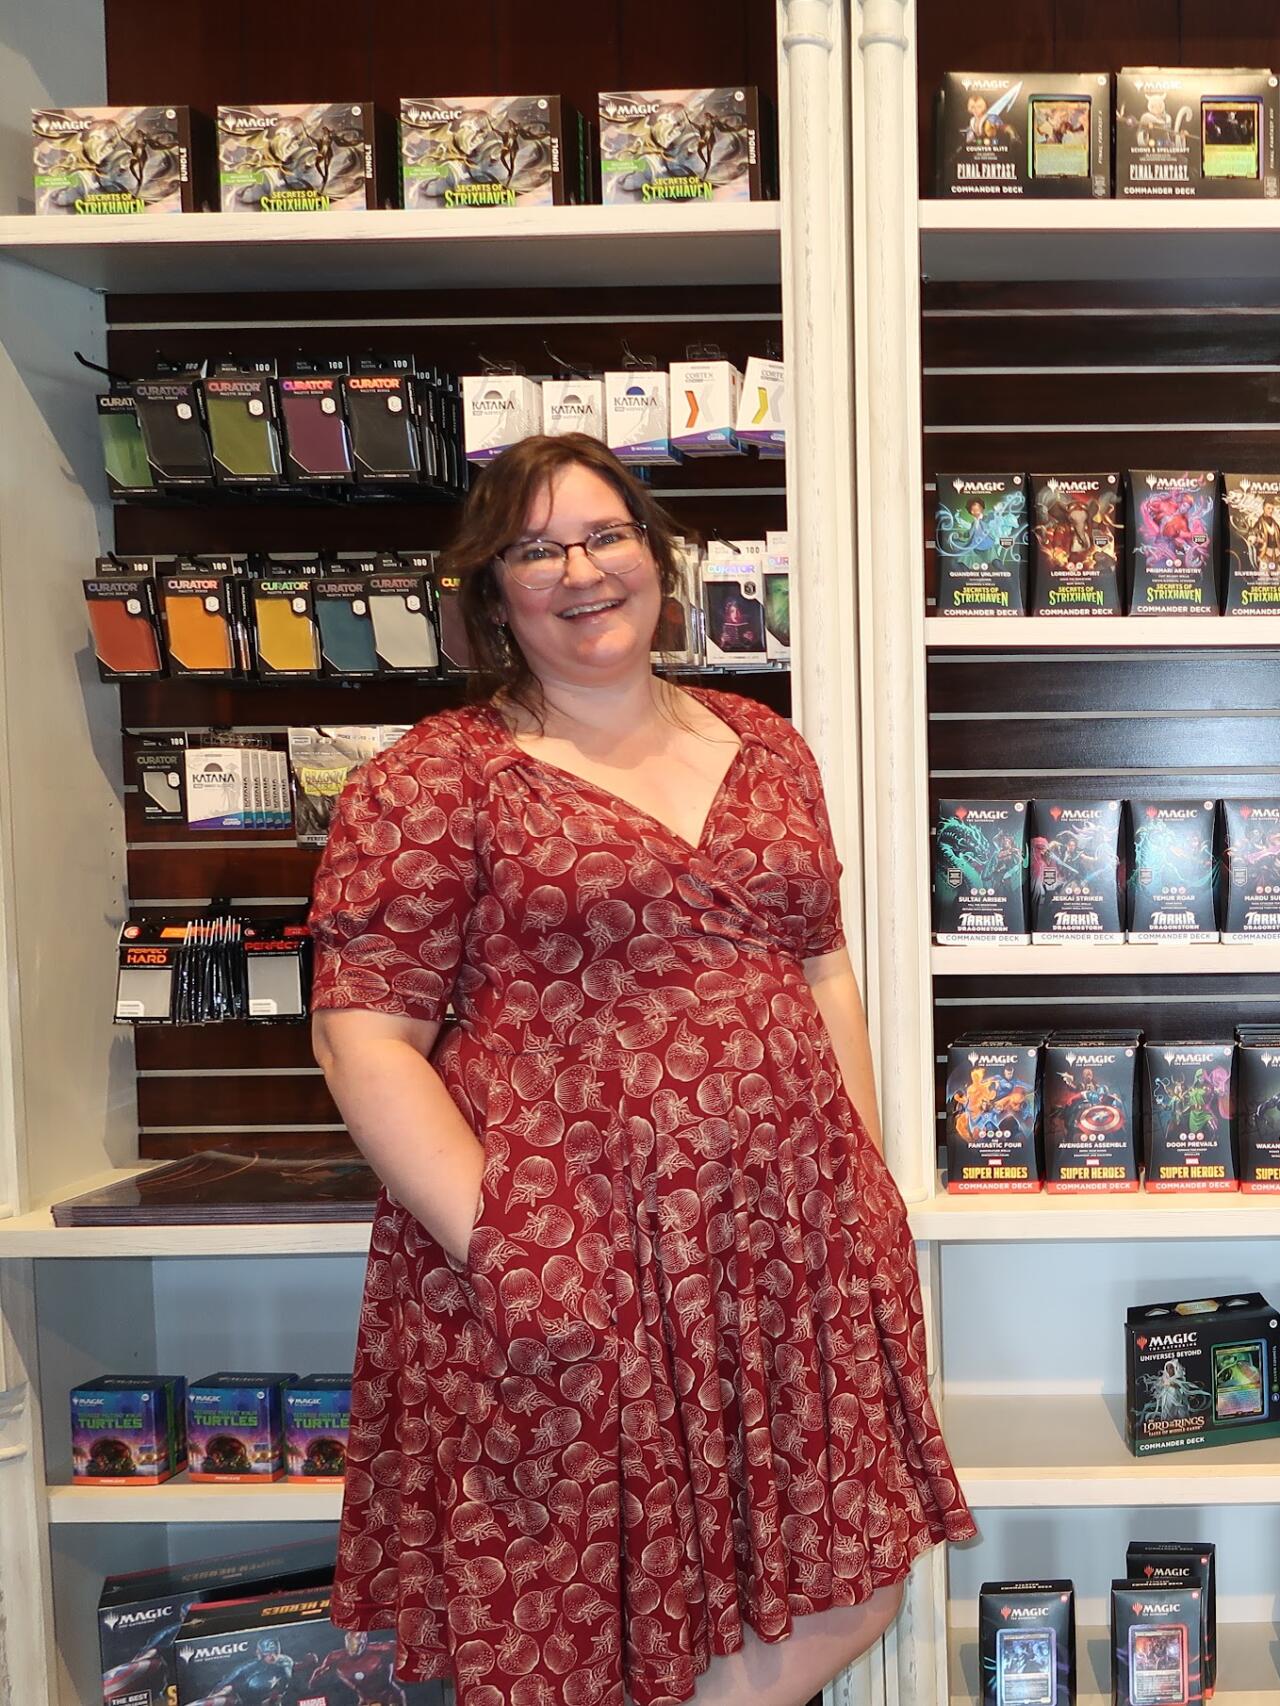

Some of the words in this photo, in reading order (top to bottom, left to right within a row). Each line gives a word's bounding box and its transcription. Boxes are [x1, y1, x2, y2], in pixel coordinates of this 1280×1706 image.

[365, 143, 373, 179] BUNDLE
[552, 138, 560, 173] BUNDLE
[180, 147, 188, 182] BUNDLE
[957, 164, 982, 179] FINAL
[983, 164, 1017, 180] FANTASY
[1129, 164, 1154, 180] FINAL
[1155, 164, 1189, 181] FANTASY
[641, 182, 713, 203] STRIXHAVEN
[951, 185, 1000, 194] COMMANDER
[1002, 185, 1024, 194] DECK
[1123, 186, 1172, 195] COMMANDER
[1173, 187, 1196, 195] DECK
[444, 190, 516, 208] STRIXHAVEN
[255, 363, 270, 371] 100
[328, 361, 343, 370] 100
[393, 360, 408, 368] 100
[208, 381, 261, 392] CURATOR
[283, 380, 334, 392] CURATOR
[349, 378, 401, 390] CURATOR
[136, 386, 188, 397] CURATOR
[472, 401, 515, 411] KATANA
[614, 397, 657, 407] KATANA
[551, 405, 593, 415] KATANA
[963, 481, 1005, 491] MAGIC
[1058, 480, 1100, 491] MAGIC
[133, 564, 149, 572] 100
[413, 558, 428, 567] 100
[87, 583, 138, 593] CURATOR
[168, 580, 219, 590] CURATOR
[260, 581, 310, 591] CURATOR
[953, 592, 1009, 607] STRIXHAVEN
[1049, 590, 1104, 606] STRIXHAVEN
[1147, 587, 1202, 603] STRIXHAVEN
[1039, 608, 1089, 616] COMMANDER
[1137, 605, 1187, 613] COMMANDER
[1189, 605, 1211, 613] DECK
[192, 774, 235, 783] KATANA
[958, 912, 1004, 927] TARKIR
[127, 954, 167, 964] HARD
[962, 1167, 992, 1180] SUPER
[993, 1166, 1028, 1179] HEROES
[1060, 1167, 1090, 1180] SUPER
[1091, 1166, 1126, 1179] HEROES
[1160, 1166, 1189, 1179] SUPER
[1190, 1166, 1225, 1178] HEROES
[1149, 1332, 1198, 1347] MAGIC
[1140, 1352, 1175, 1362] UNIVERSES
[1176, 1349, 1202, 1358] BEYOND
[78, 1417, 143, 1429] TURTLES
[194, 1415, 258, 1427] TURTLES
[1143, 1421, 1168, 1435] LORD
[1174, 1416, 1205, 1428] RINGS
[118, 1606, 173, 1625] MAGIC
[193, 1641, 249, 1660] MAGIC
